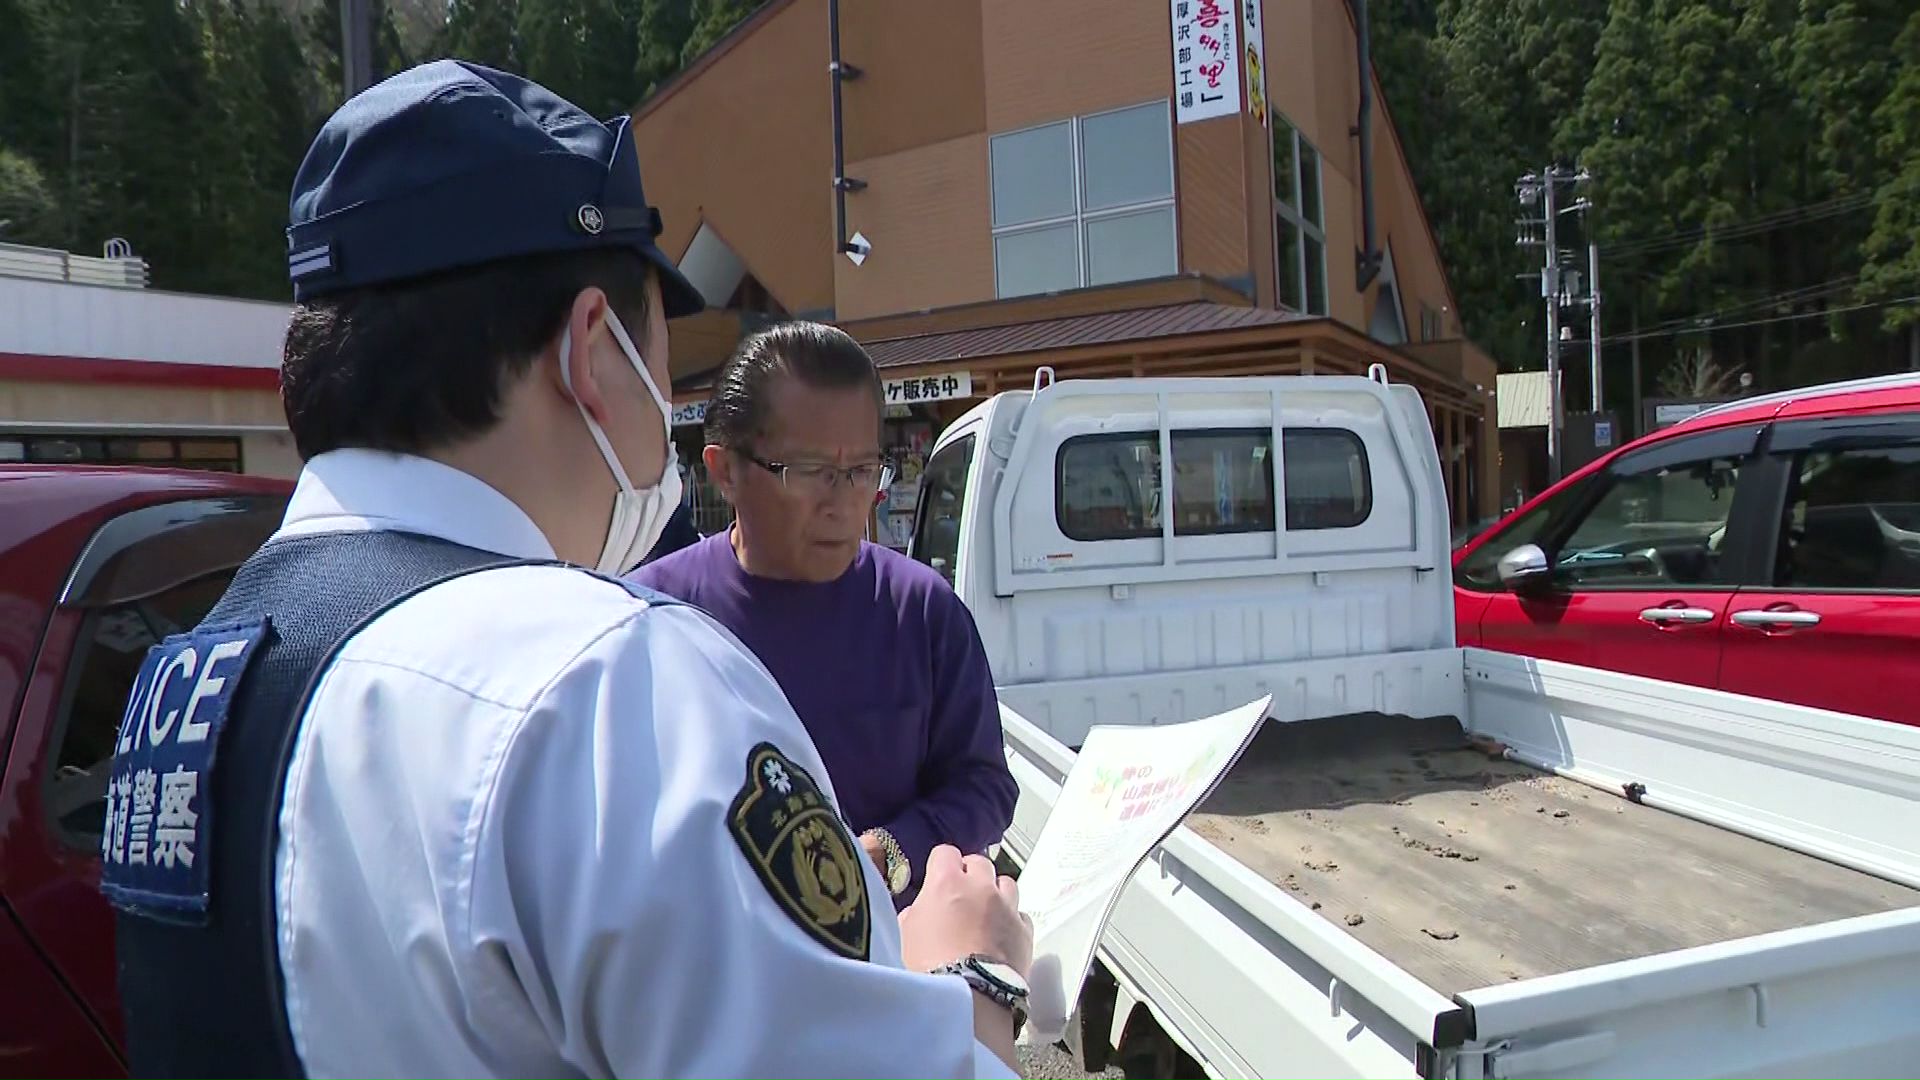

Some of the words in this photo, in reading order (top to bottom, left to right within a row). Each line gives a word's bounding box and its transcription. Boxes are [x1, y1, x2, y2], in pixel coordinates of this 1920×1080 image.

[1176, 1, 1194, 108] 厚沢部工場
[887, 375, 958, 400] ケ販売中
[114, 639, 249, 756] LICE
